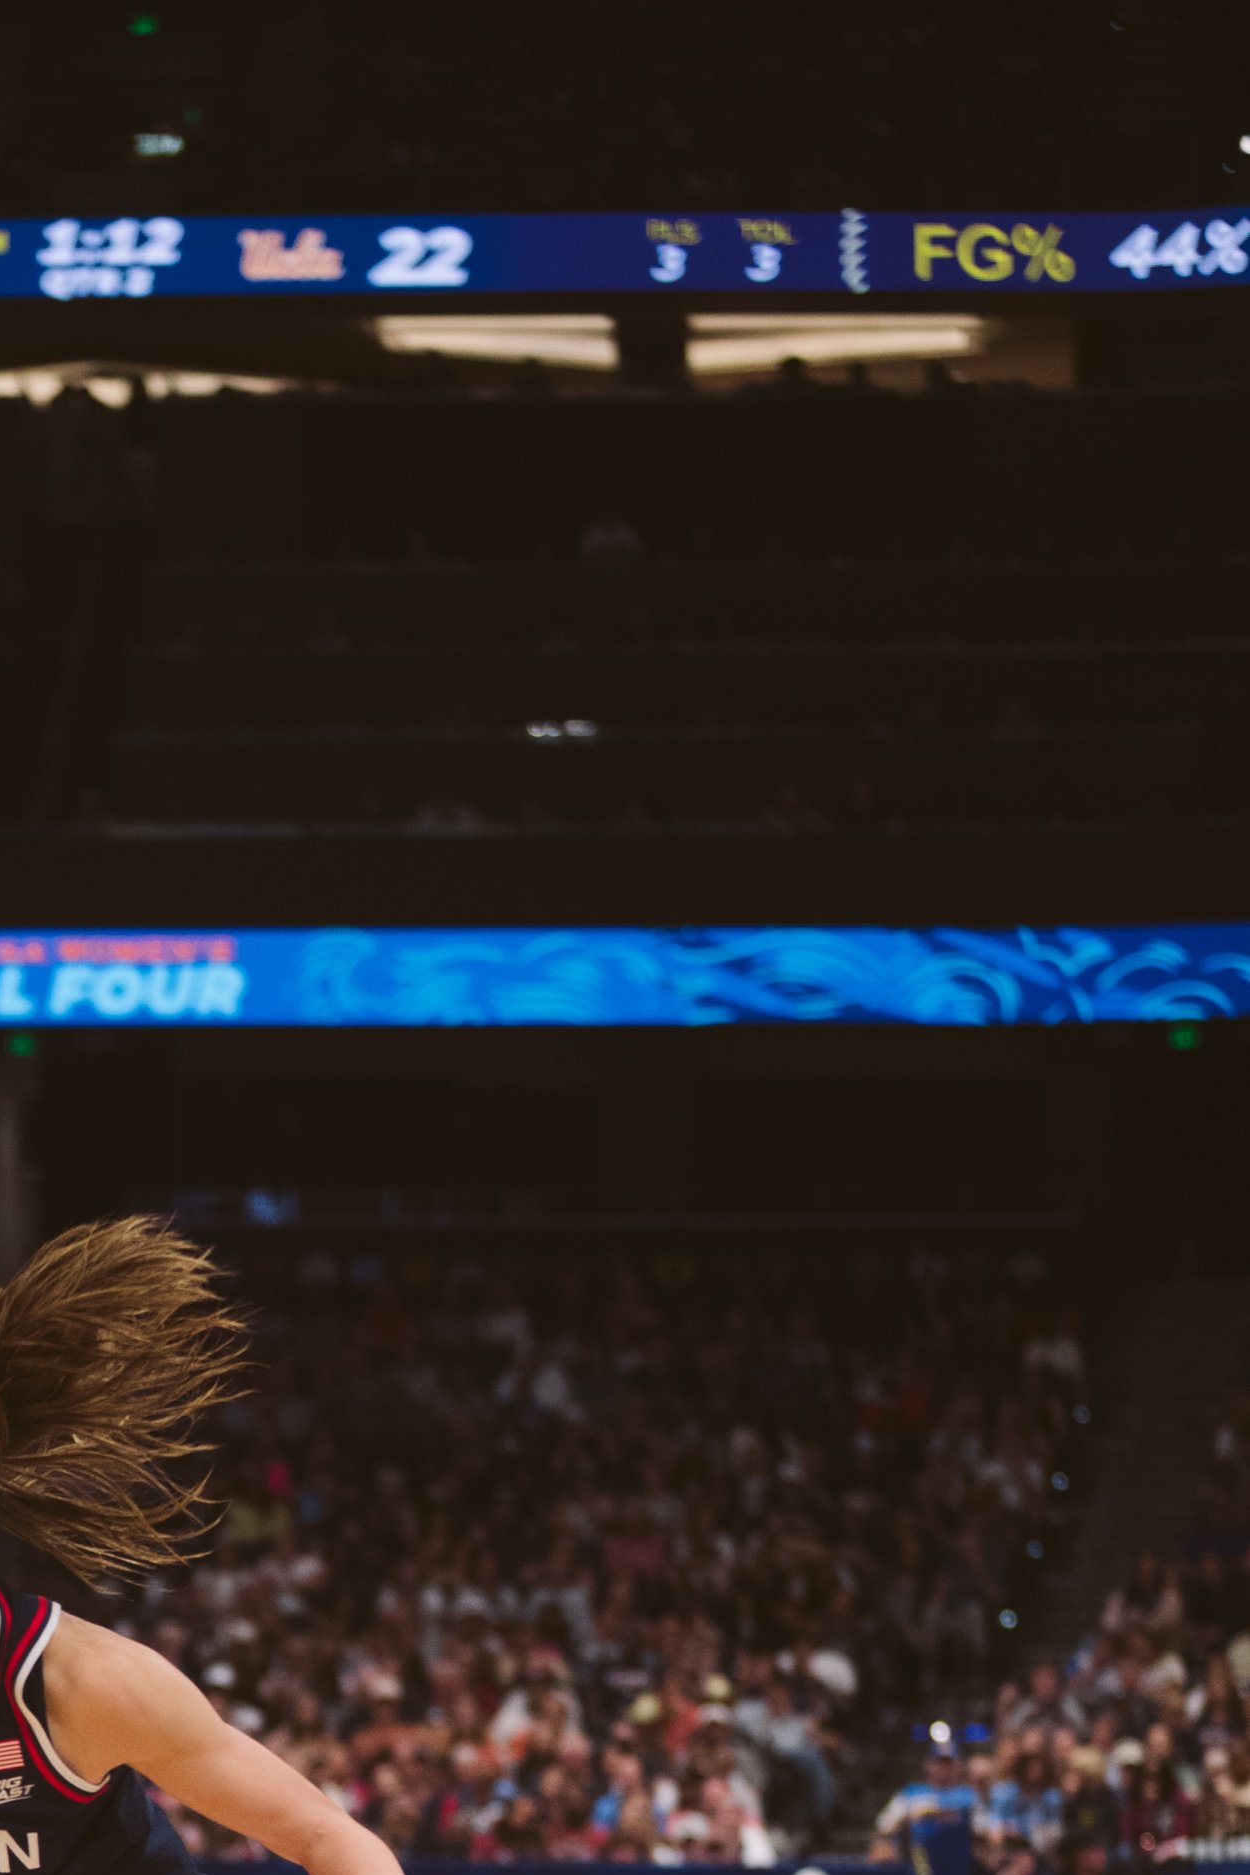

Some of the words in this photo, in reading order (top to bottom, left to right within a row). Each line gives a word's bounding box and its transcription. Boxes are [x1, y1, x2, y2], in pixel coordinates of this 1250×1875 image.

[36, 216, 184, 267] 1:12
[366, 225, 474, 288] 22
[649, 243, 688, 283] 3
[744, 243, 782, 283] 3
[913, 222, 1077, 283] FG%
[1108, 217, 1250, 280] 44%
[47, 964, 244, 1018] FOUR
